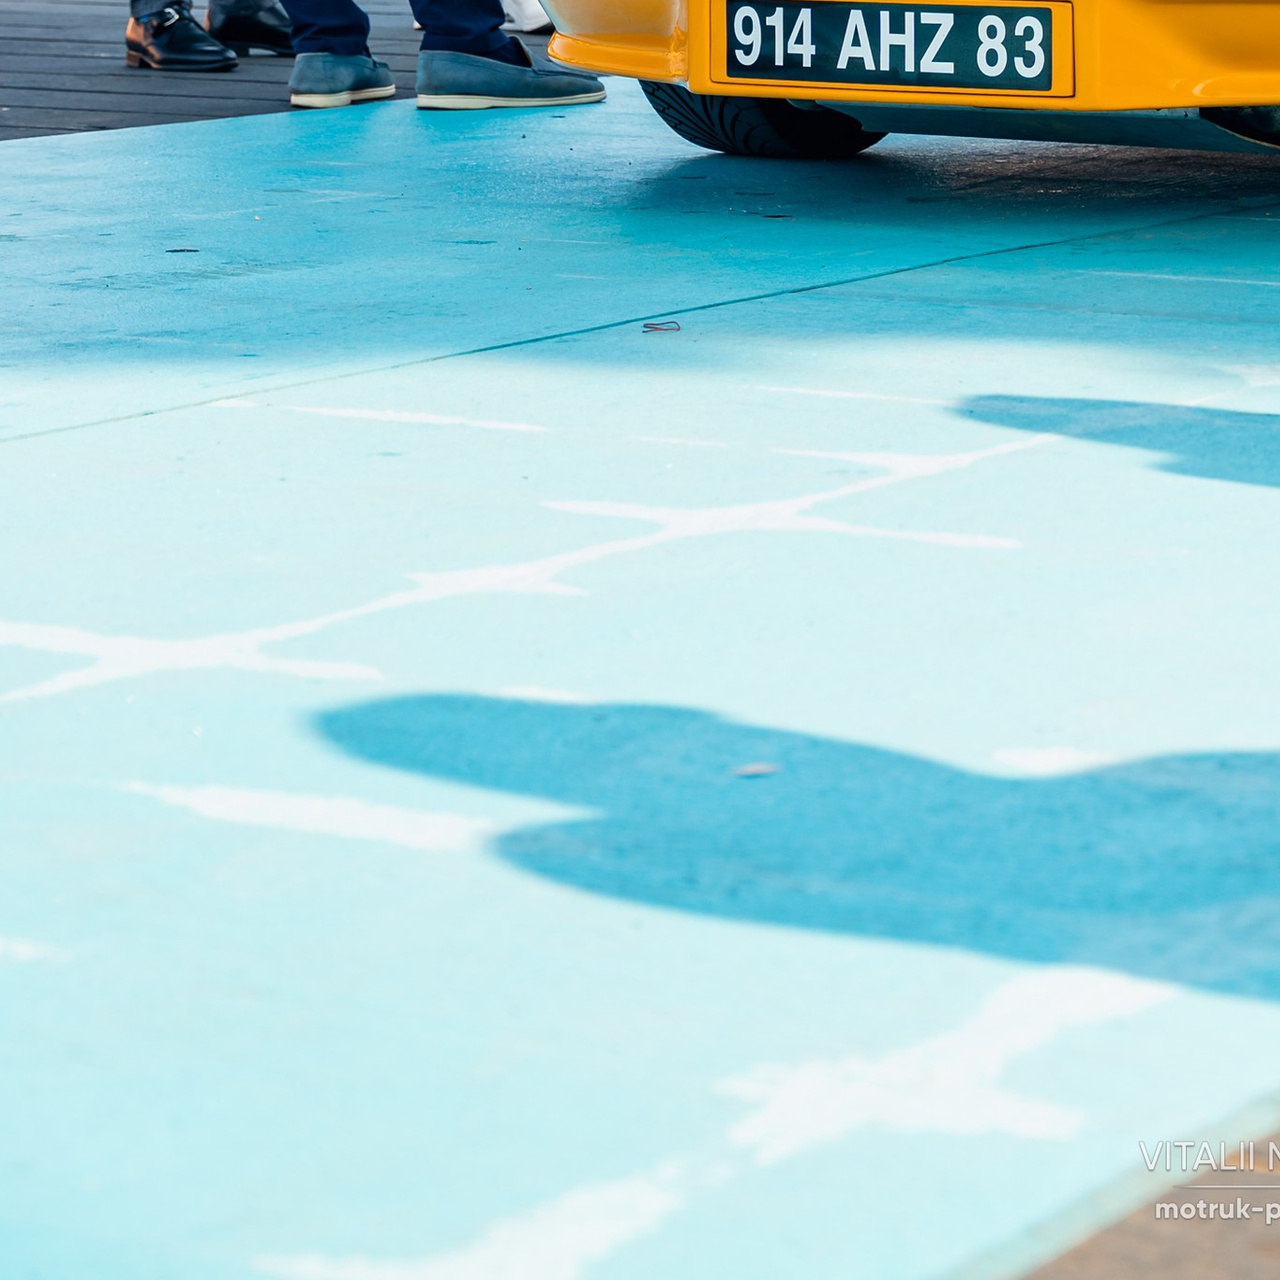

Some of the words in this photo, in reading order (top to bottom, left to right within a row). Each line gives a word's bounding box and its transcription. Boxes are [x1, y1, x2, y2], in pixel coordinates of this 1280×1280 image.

[733, 5, 817, 68] 914
[836, 8, 956, 75] AHZ
[975, 14, 1046, 78] 83
